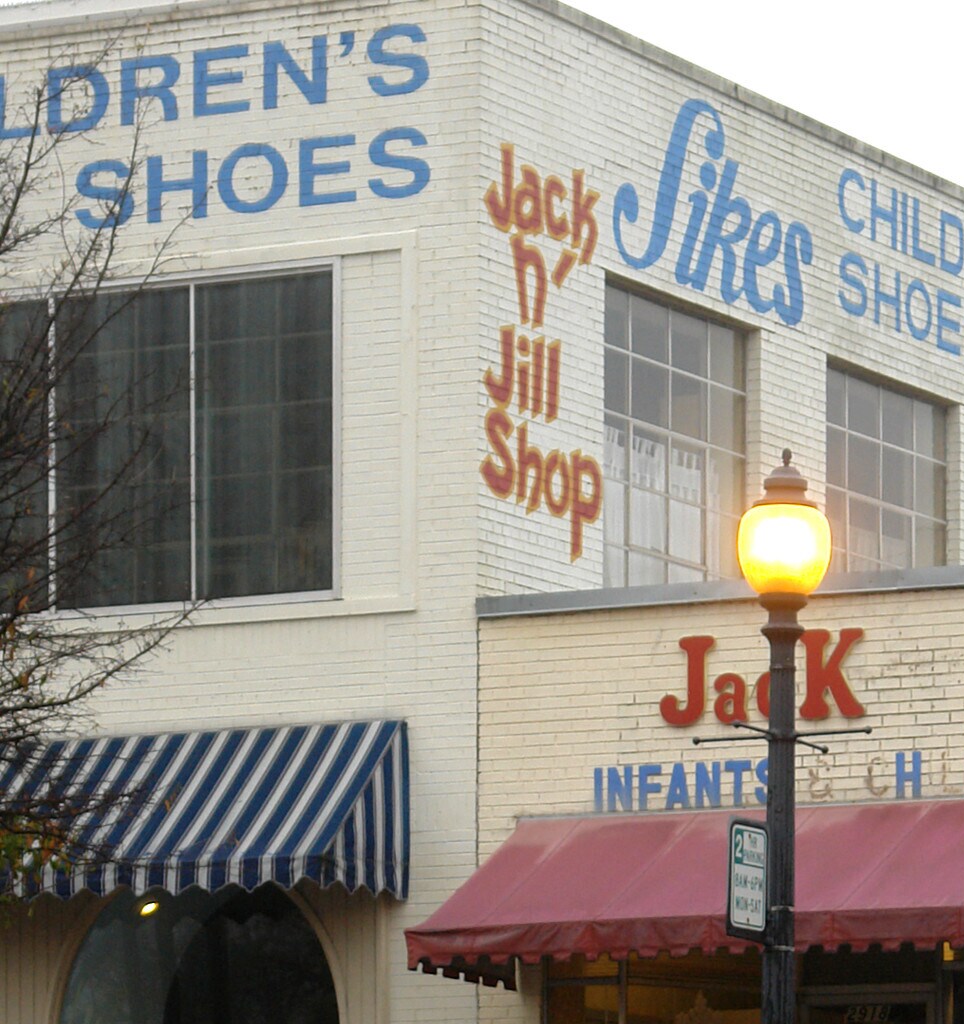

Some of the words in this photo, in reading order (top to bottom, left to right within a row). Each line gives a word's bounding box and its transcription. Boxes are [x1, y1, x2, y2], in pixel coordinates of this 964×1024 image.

[0, 23, 431, 140] LDREN'S
[74, 126, 431, 229] SHOES
[484, 143, 600, 264] Jack
[482, 325, 562, 424] Jill
[479, 406, 602, 563] Shop
[593, 757, 768, 813] INFANTS
[735, 833, 743, 858] 2
[847, 1005, 888, 1021] 2918
